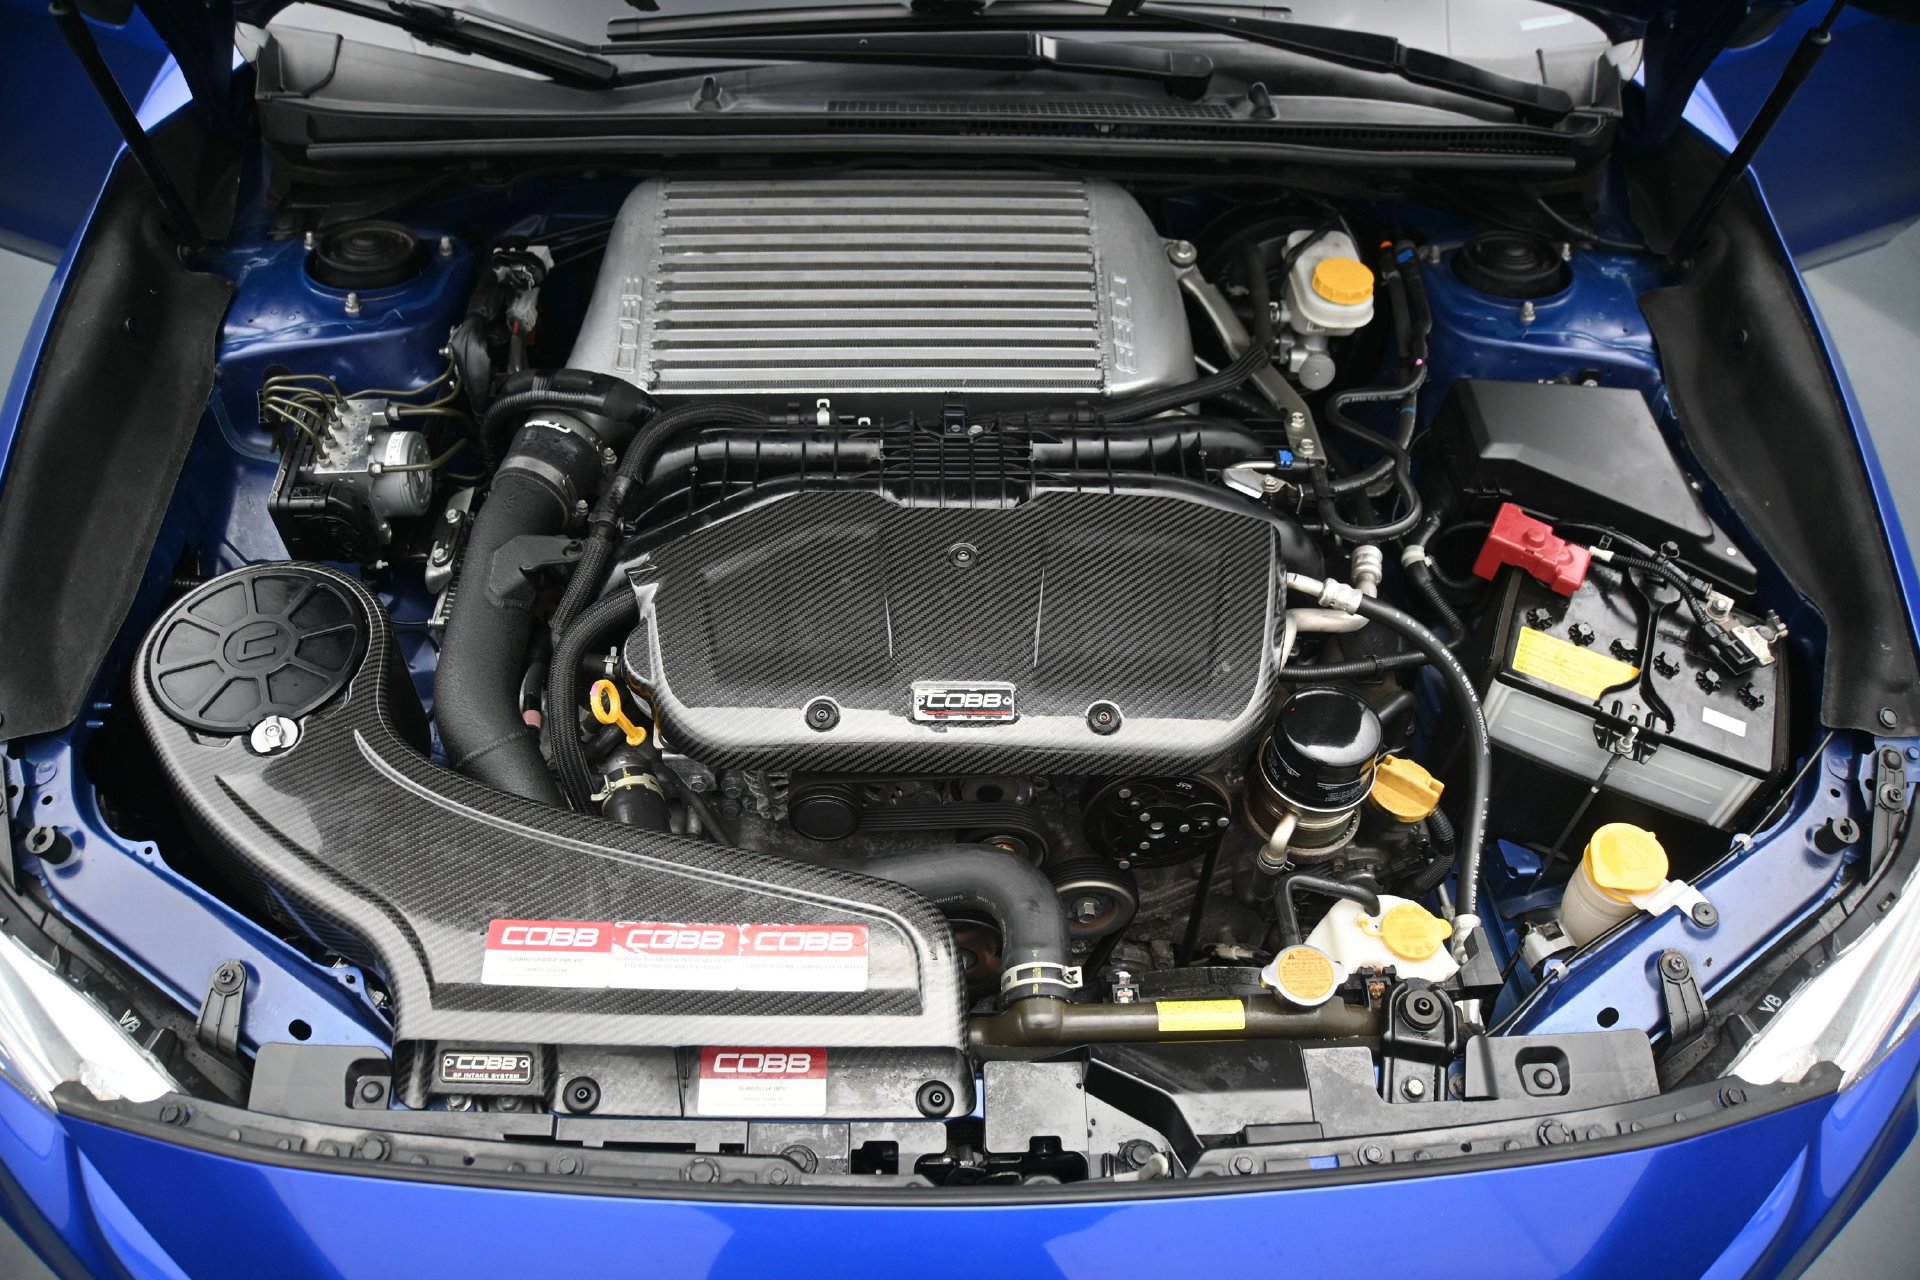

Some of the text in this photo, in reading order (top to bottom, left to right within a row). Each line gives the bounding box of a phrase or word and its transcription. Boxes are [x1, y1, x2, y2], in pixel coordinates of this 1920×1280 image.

[926, 693, 1002, 708] COBB
[1476, 706, 1488, 745] YOKOHAMA
[501, 926, 600, 947] COBB
[625, 929, 725, 950] COBB
[753, 931, 854, 951] COBB
[456, 1056, 517, 1070] COBB
[713, 1053, 811, 1073] COBB
